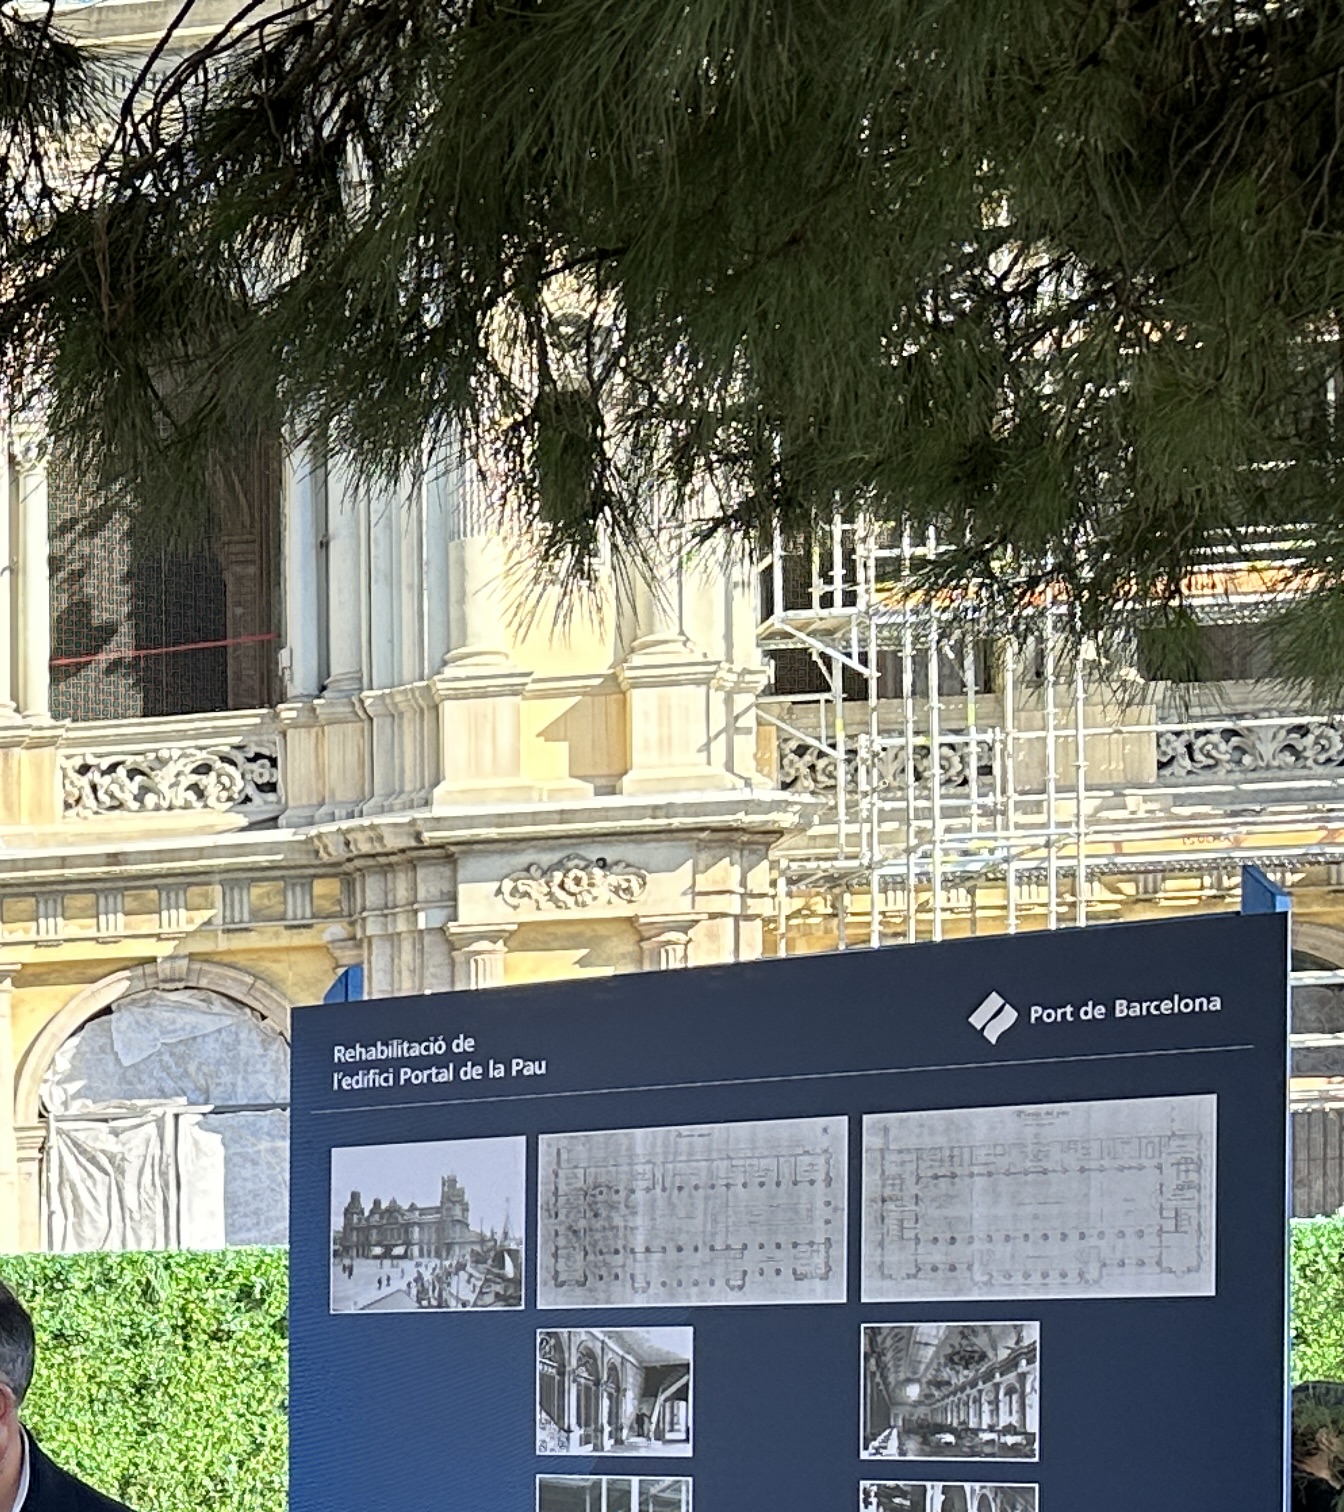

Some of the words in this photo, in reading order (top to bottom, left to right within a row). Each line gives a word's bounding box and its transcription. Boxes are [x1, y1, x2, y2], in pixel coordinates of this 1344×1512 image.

[1029, 1003, 1074, 1024] Port
[1079, 1000, 1106, 1020] de
[1114, 994, 1222, 1018] Barcelona
[333, 1034, 447, 1063] Rehabilitació
[451, 1033, 476, 1053] de
[332, 1067, 394, 1091] l'edifici
[399, 1062, 454, 1086] Portal
[459, 1061, 483, 1081] de
[488, 1059, 505, 1079] la
[511, 1057, 547, 1077] Pau
